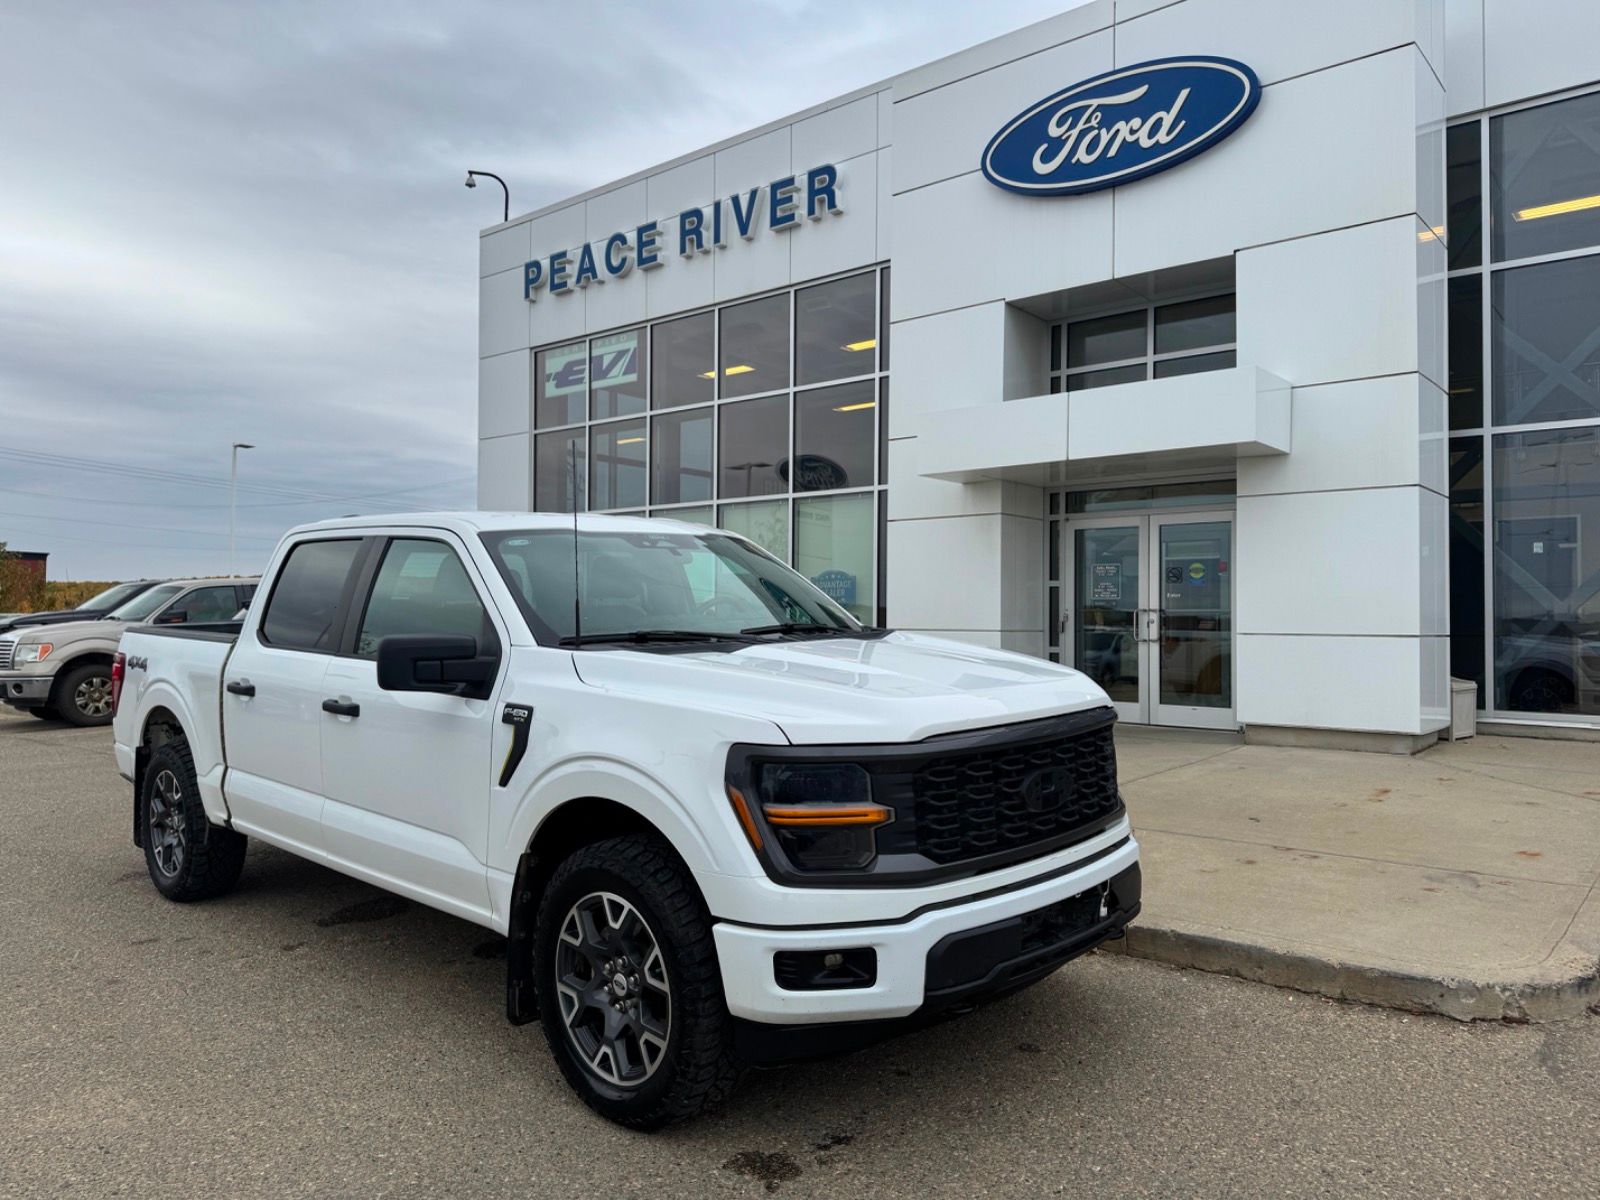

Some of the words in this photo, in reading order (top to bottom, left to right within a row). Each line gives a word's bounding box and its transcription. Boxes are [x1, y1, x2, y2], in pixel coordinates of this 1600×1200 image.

[1032, 84, 1192, 175] Ford
[523, 221, 661, 301] PEACE
[679, 163, 842, 257] RIVER
